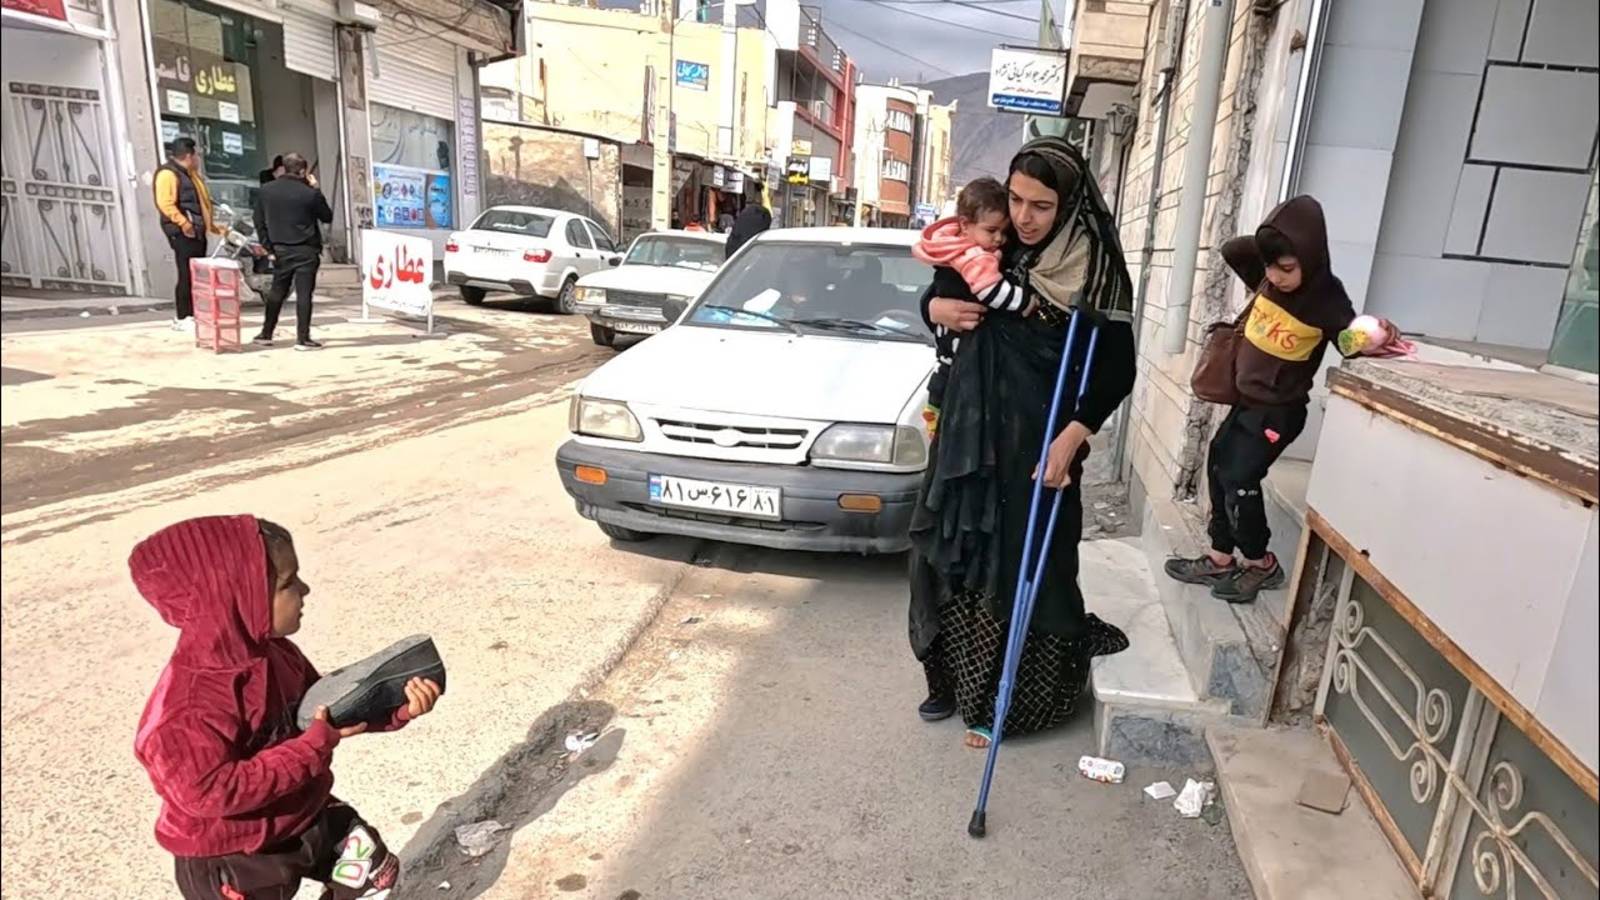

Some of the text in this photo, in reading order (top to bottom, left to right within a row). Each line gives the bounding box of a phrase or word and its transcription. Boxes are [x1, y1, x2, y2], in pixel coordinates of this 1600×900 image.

[195, 65, 235, 95] عطاری
[1042, 64, 1065, 84] دکتر
[370, 244, 425, 289] عطاری
